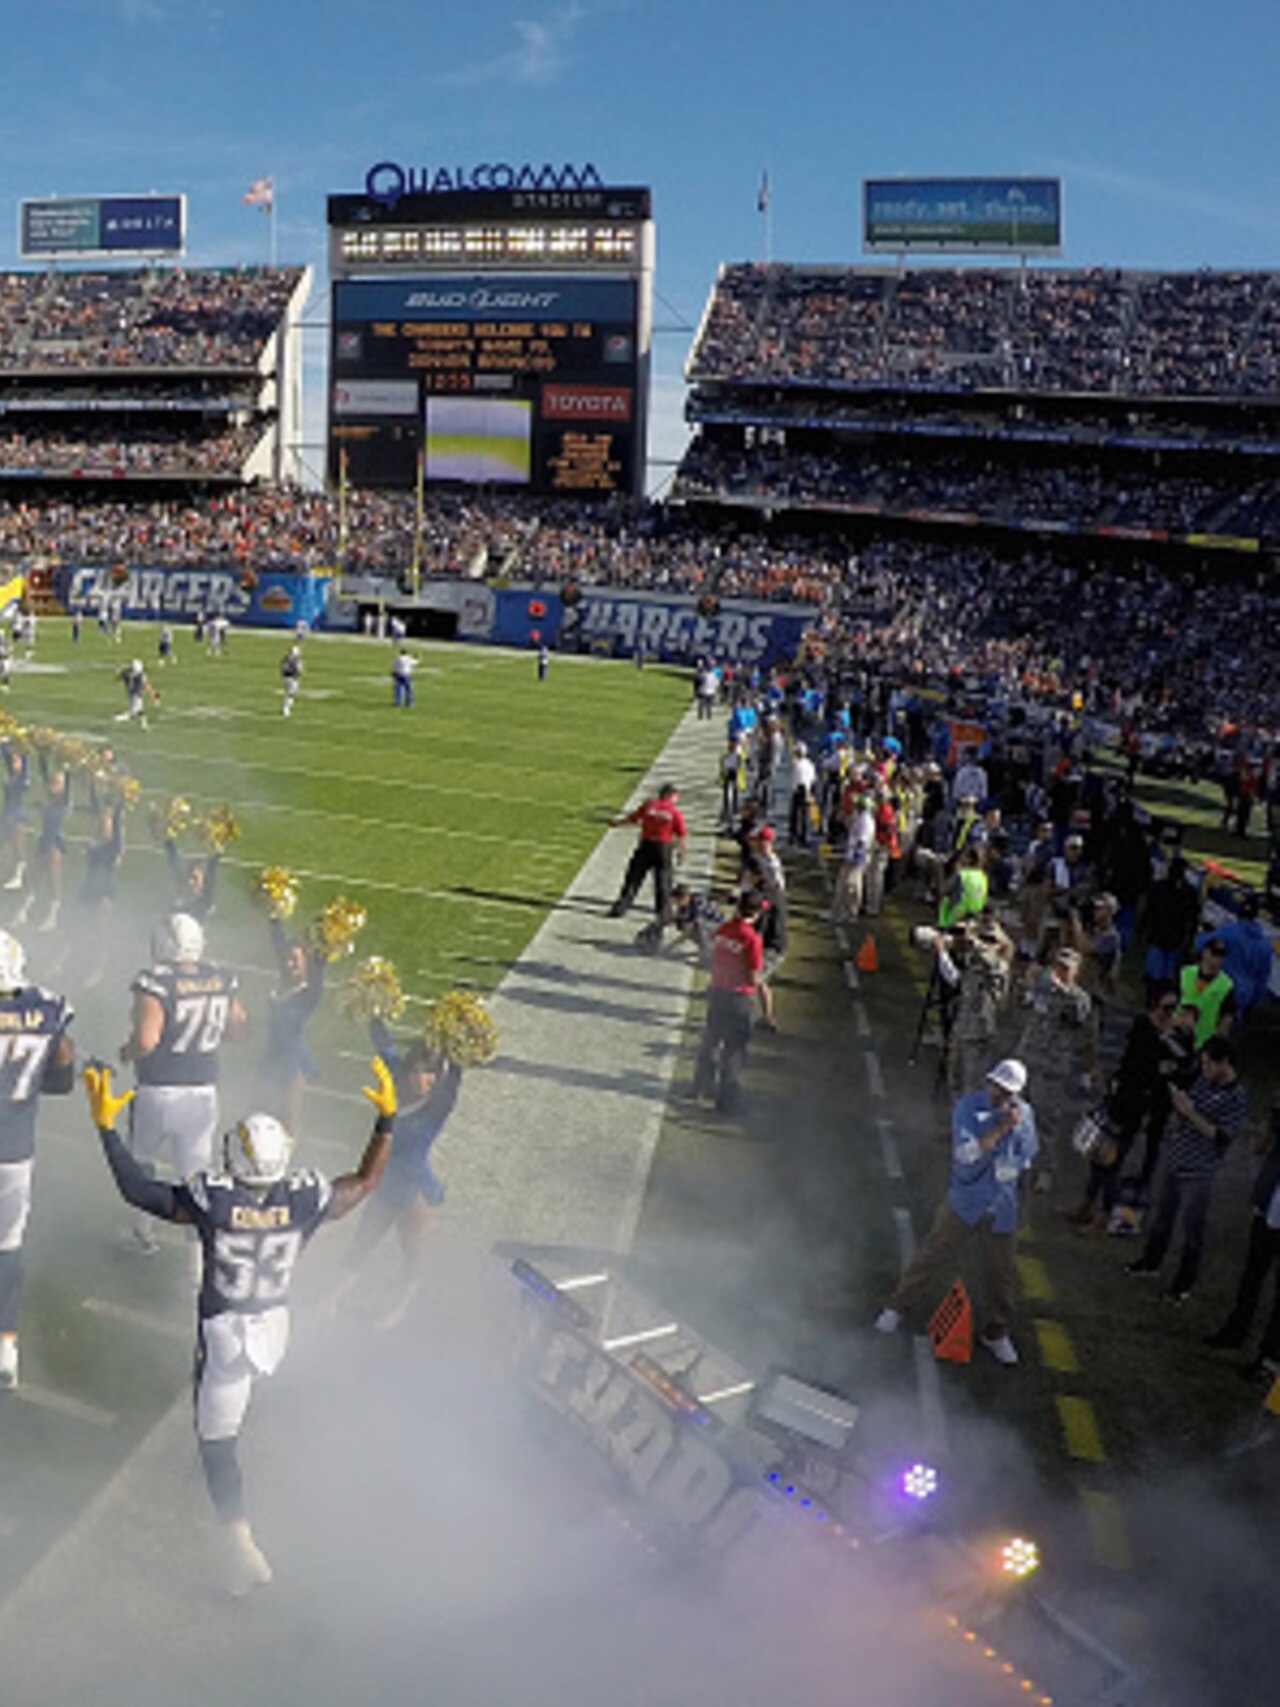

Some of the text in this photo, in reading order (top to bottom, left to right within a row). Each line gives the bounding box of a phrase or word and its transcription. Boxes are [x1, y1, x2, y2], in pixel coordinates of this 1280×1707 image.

[366, 162, 604, 209] QUALCOMM
[548, 395, 626, 412] TOYOTA
[68, 568, 252, 614] CHARGERS
[575, 599, 773, 659] HARGERS
[213, 1230, 304, 1301] 53
